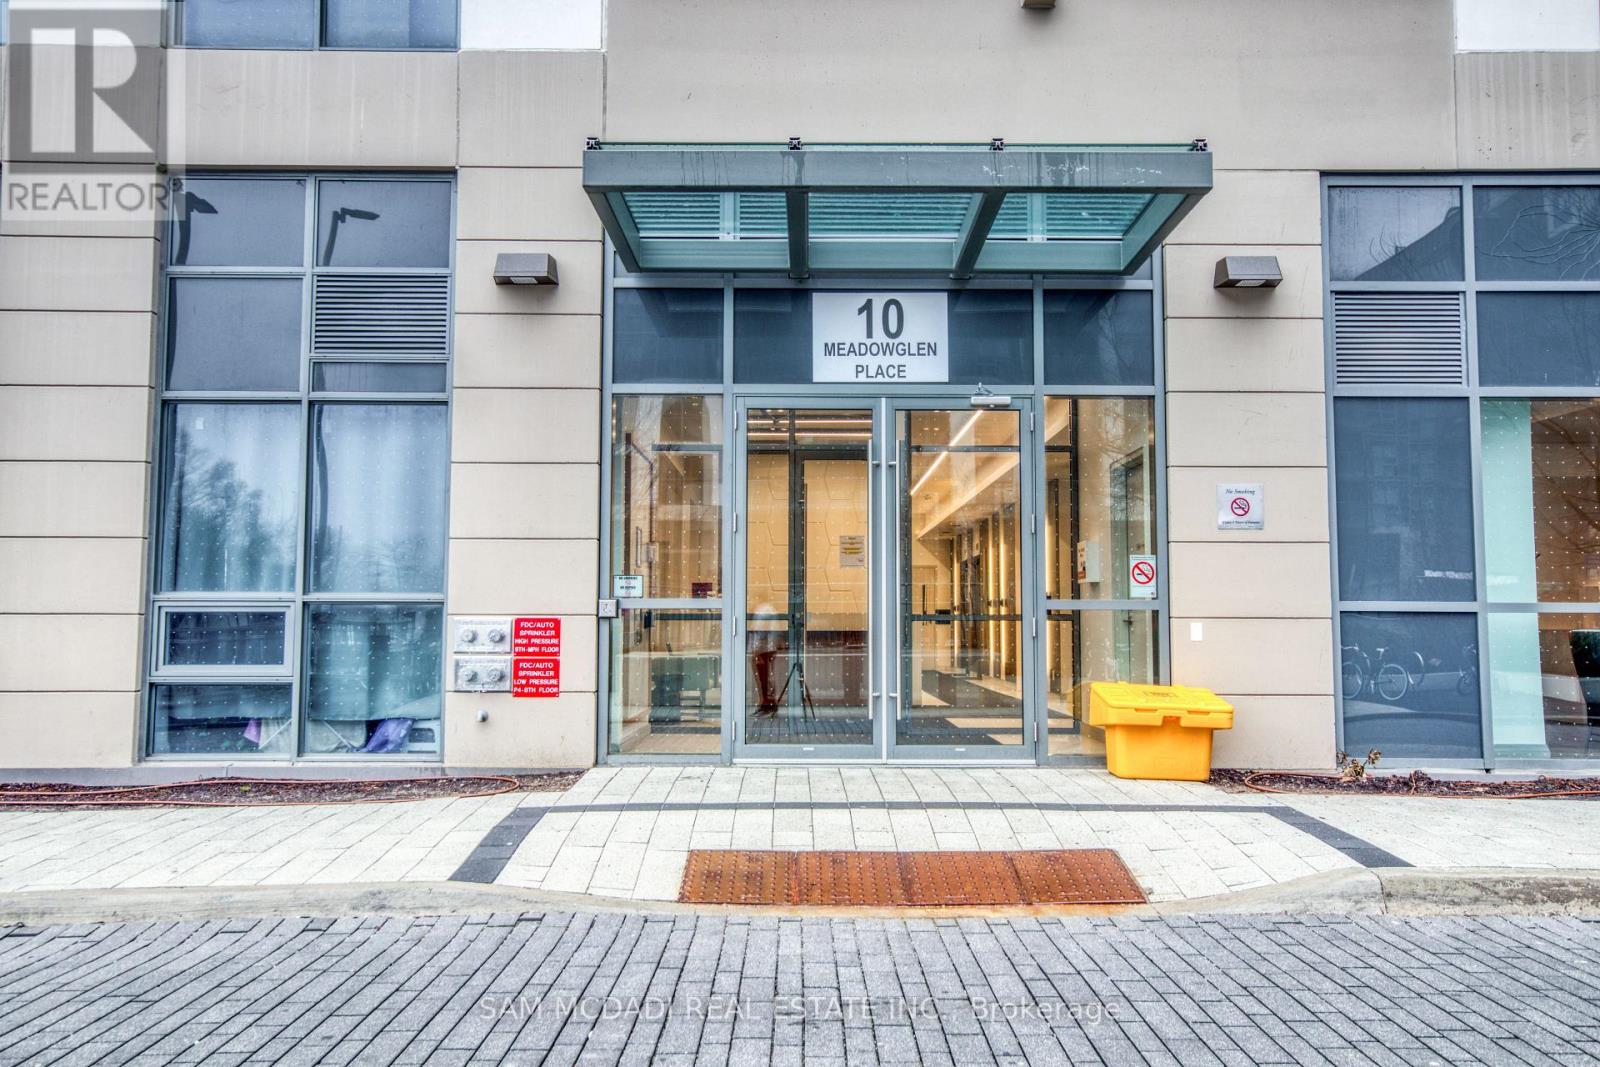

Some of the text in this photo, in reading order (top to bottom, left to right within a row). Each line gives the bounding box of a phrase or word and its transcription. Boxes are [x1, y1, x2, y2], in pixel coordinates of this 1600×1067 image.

[857, 298, 904, 340] 10
[823, 342, 937, 357] MEADOWGLEN
[855, 364, 907, 379] PLACE
